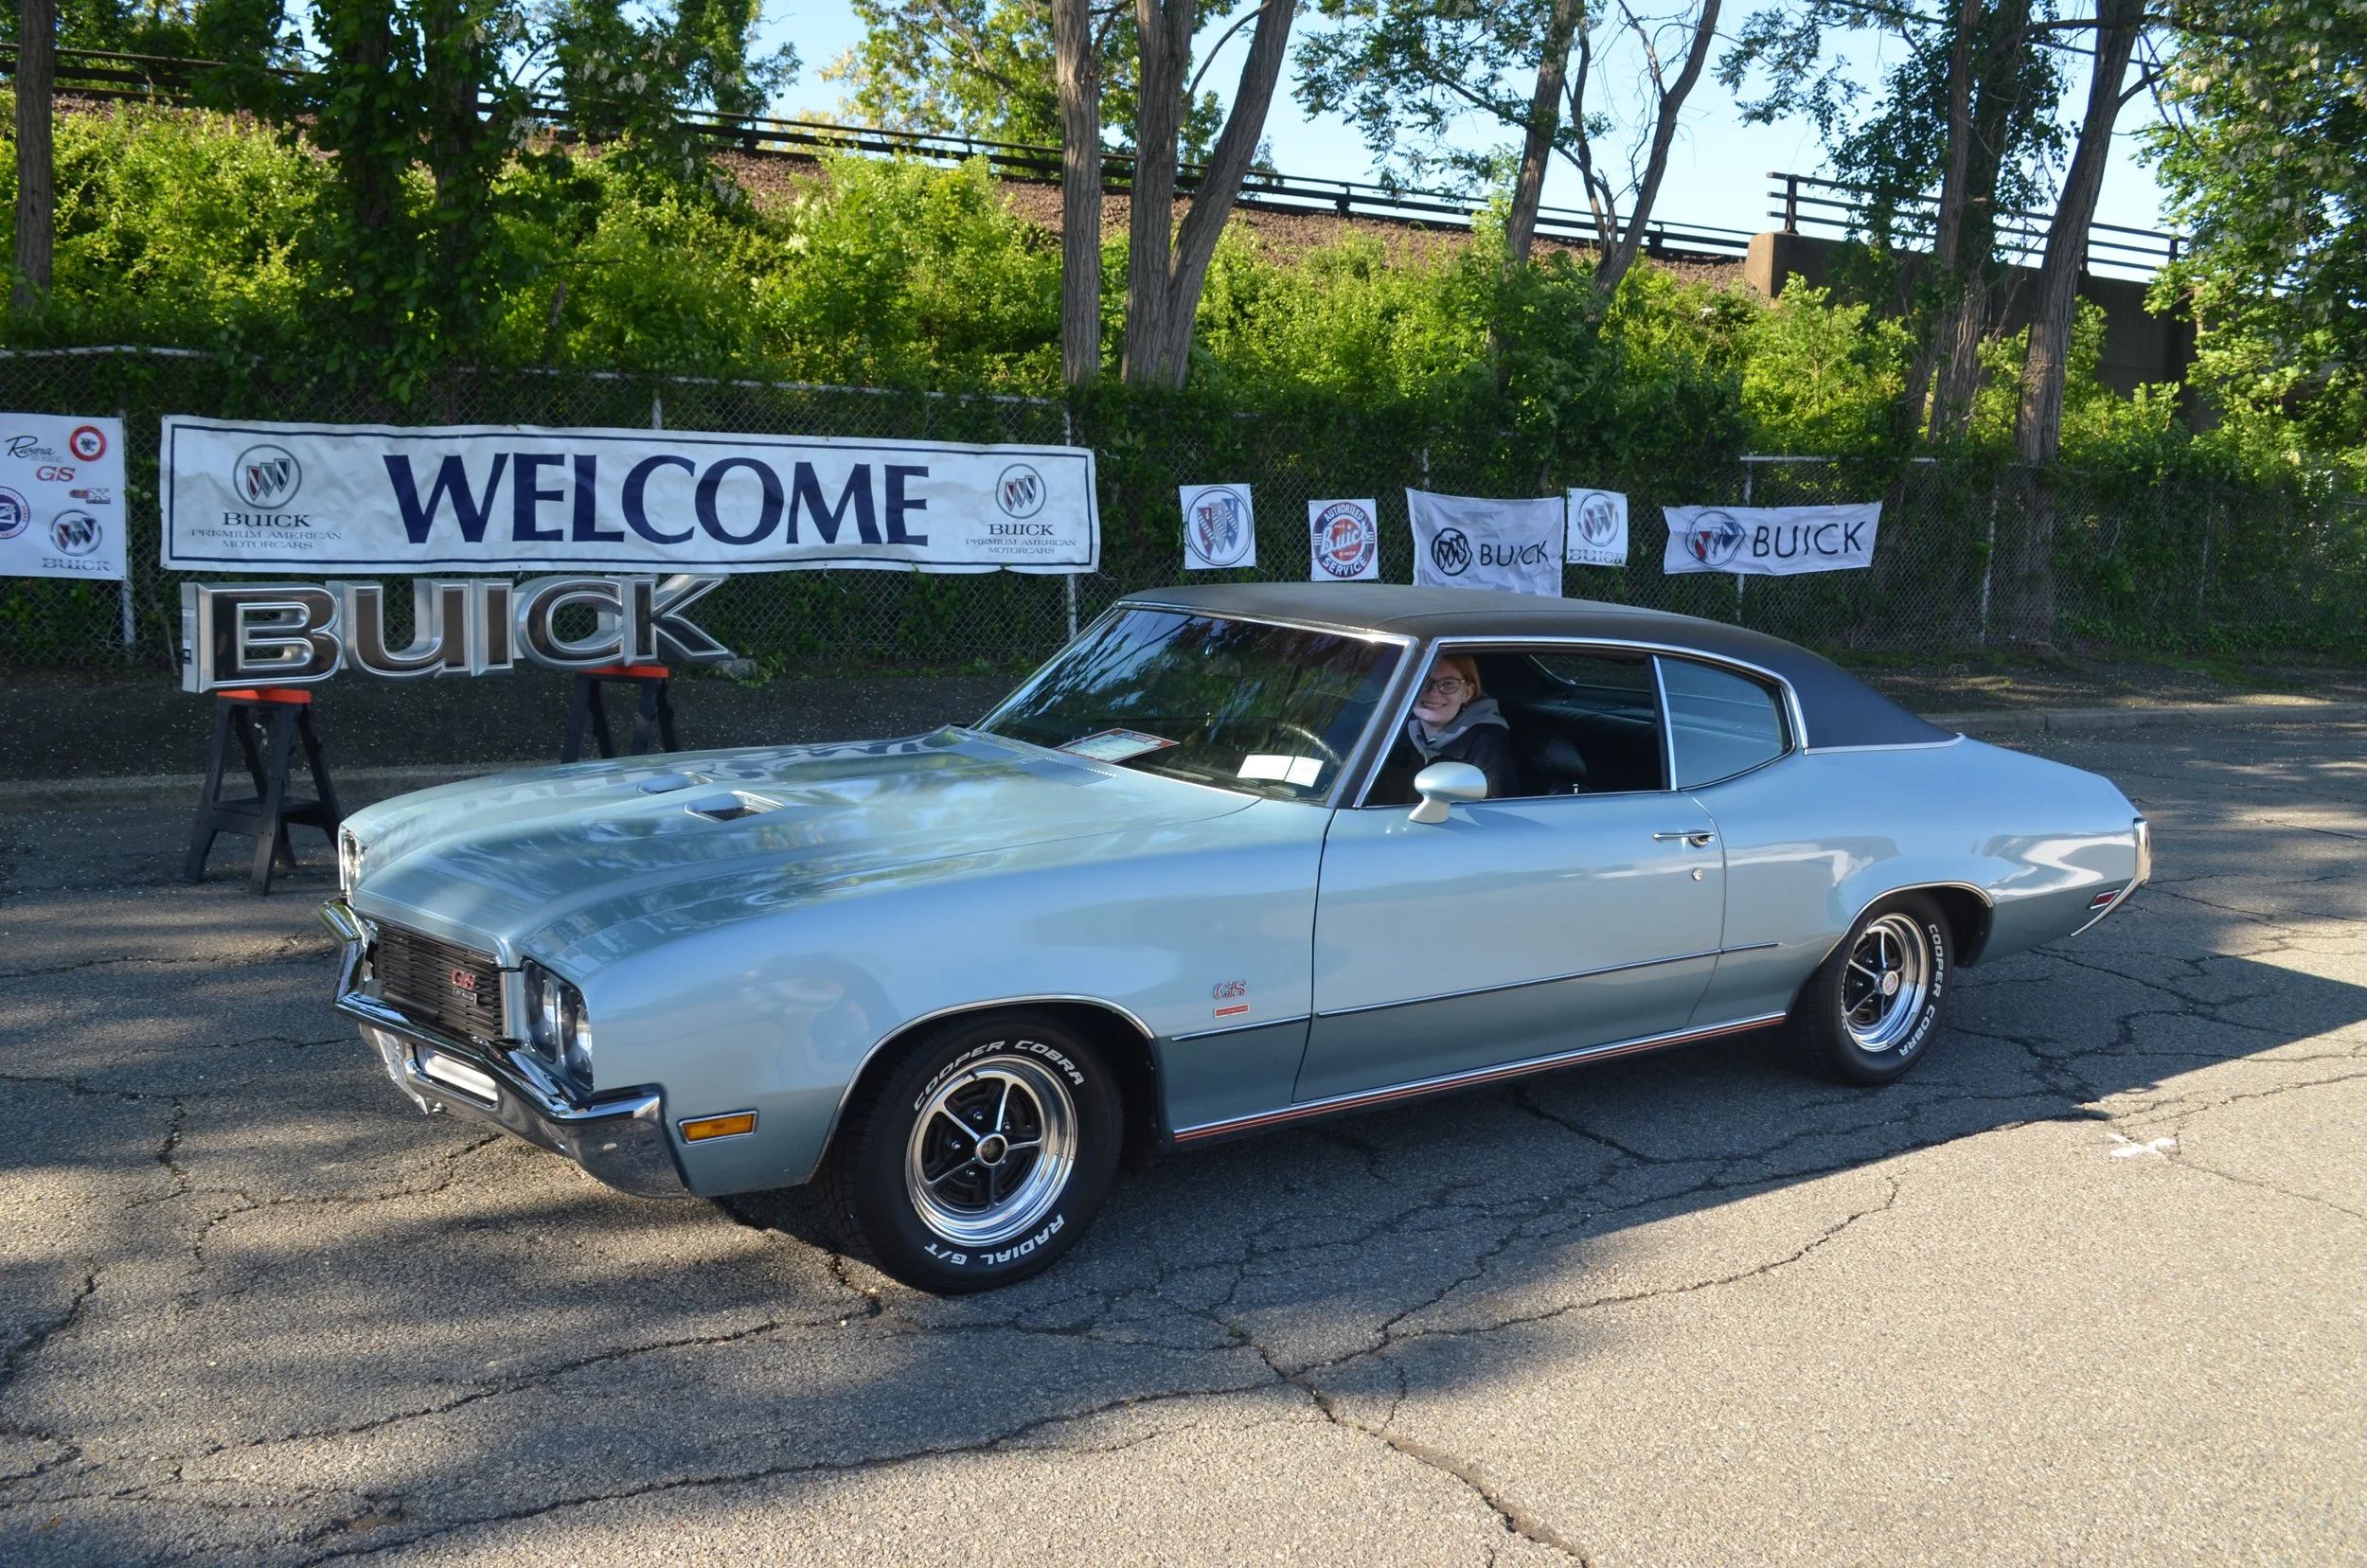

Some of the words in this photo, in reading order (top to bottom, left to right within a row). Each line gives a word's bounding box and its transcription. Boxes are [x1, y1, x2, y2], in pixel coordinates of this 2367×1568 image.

[36, 466, 76, 482] GS
[383, 453, 929, 546] WELCOME
[222, 512, 311, 527] BUICK
[1324, 504, 1364, 522] AUTHORIZED
[191, 529, 261, 539] PREMIUM
[266, 530, 342, 540] AMERICAN
[988, 524, 1055, 536] BUICK
[1320, 521, 1370, 556] Buick
[1753, 521, 1867, 559] BUICK
[222, 540, 313, 549] MOTORCARS
[1480, 540, 1549, 567] BUICK
[41, 557, 111, 572] BUICK
[1322, 557, 1367, 576] SERVICE
[1567, 548, 1626, 565] BUICK
[182, 574, 737, 693] BUICK
[1929, 923, 1944, 998] COOPER
[452, 969, 476, 991] GS
[1213, 980, 1247, 1000] GS
[1899, 1004, 1935, 1057] COBRA
[914, 1040, 1006, 1113] COOPER
[1014, 1040, 1085, 1086] COBRA
[980, 1213, 1065, 1265] RADIAL
[924, 1242, 968, 1265] G/T
